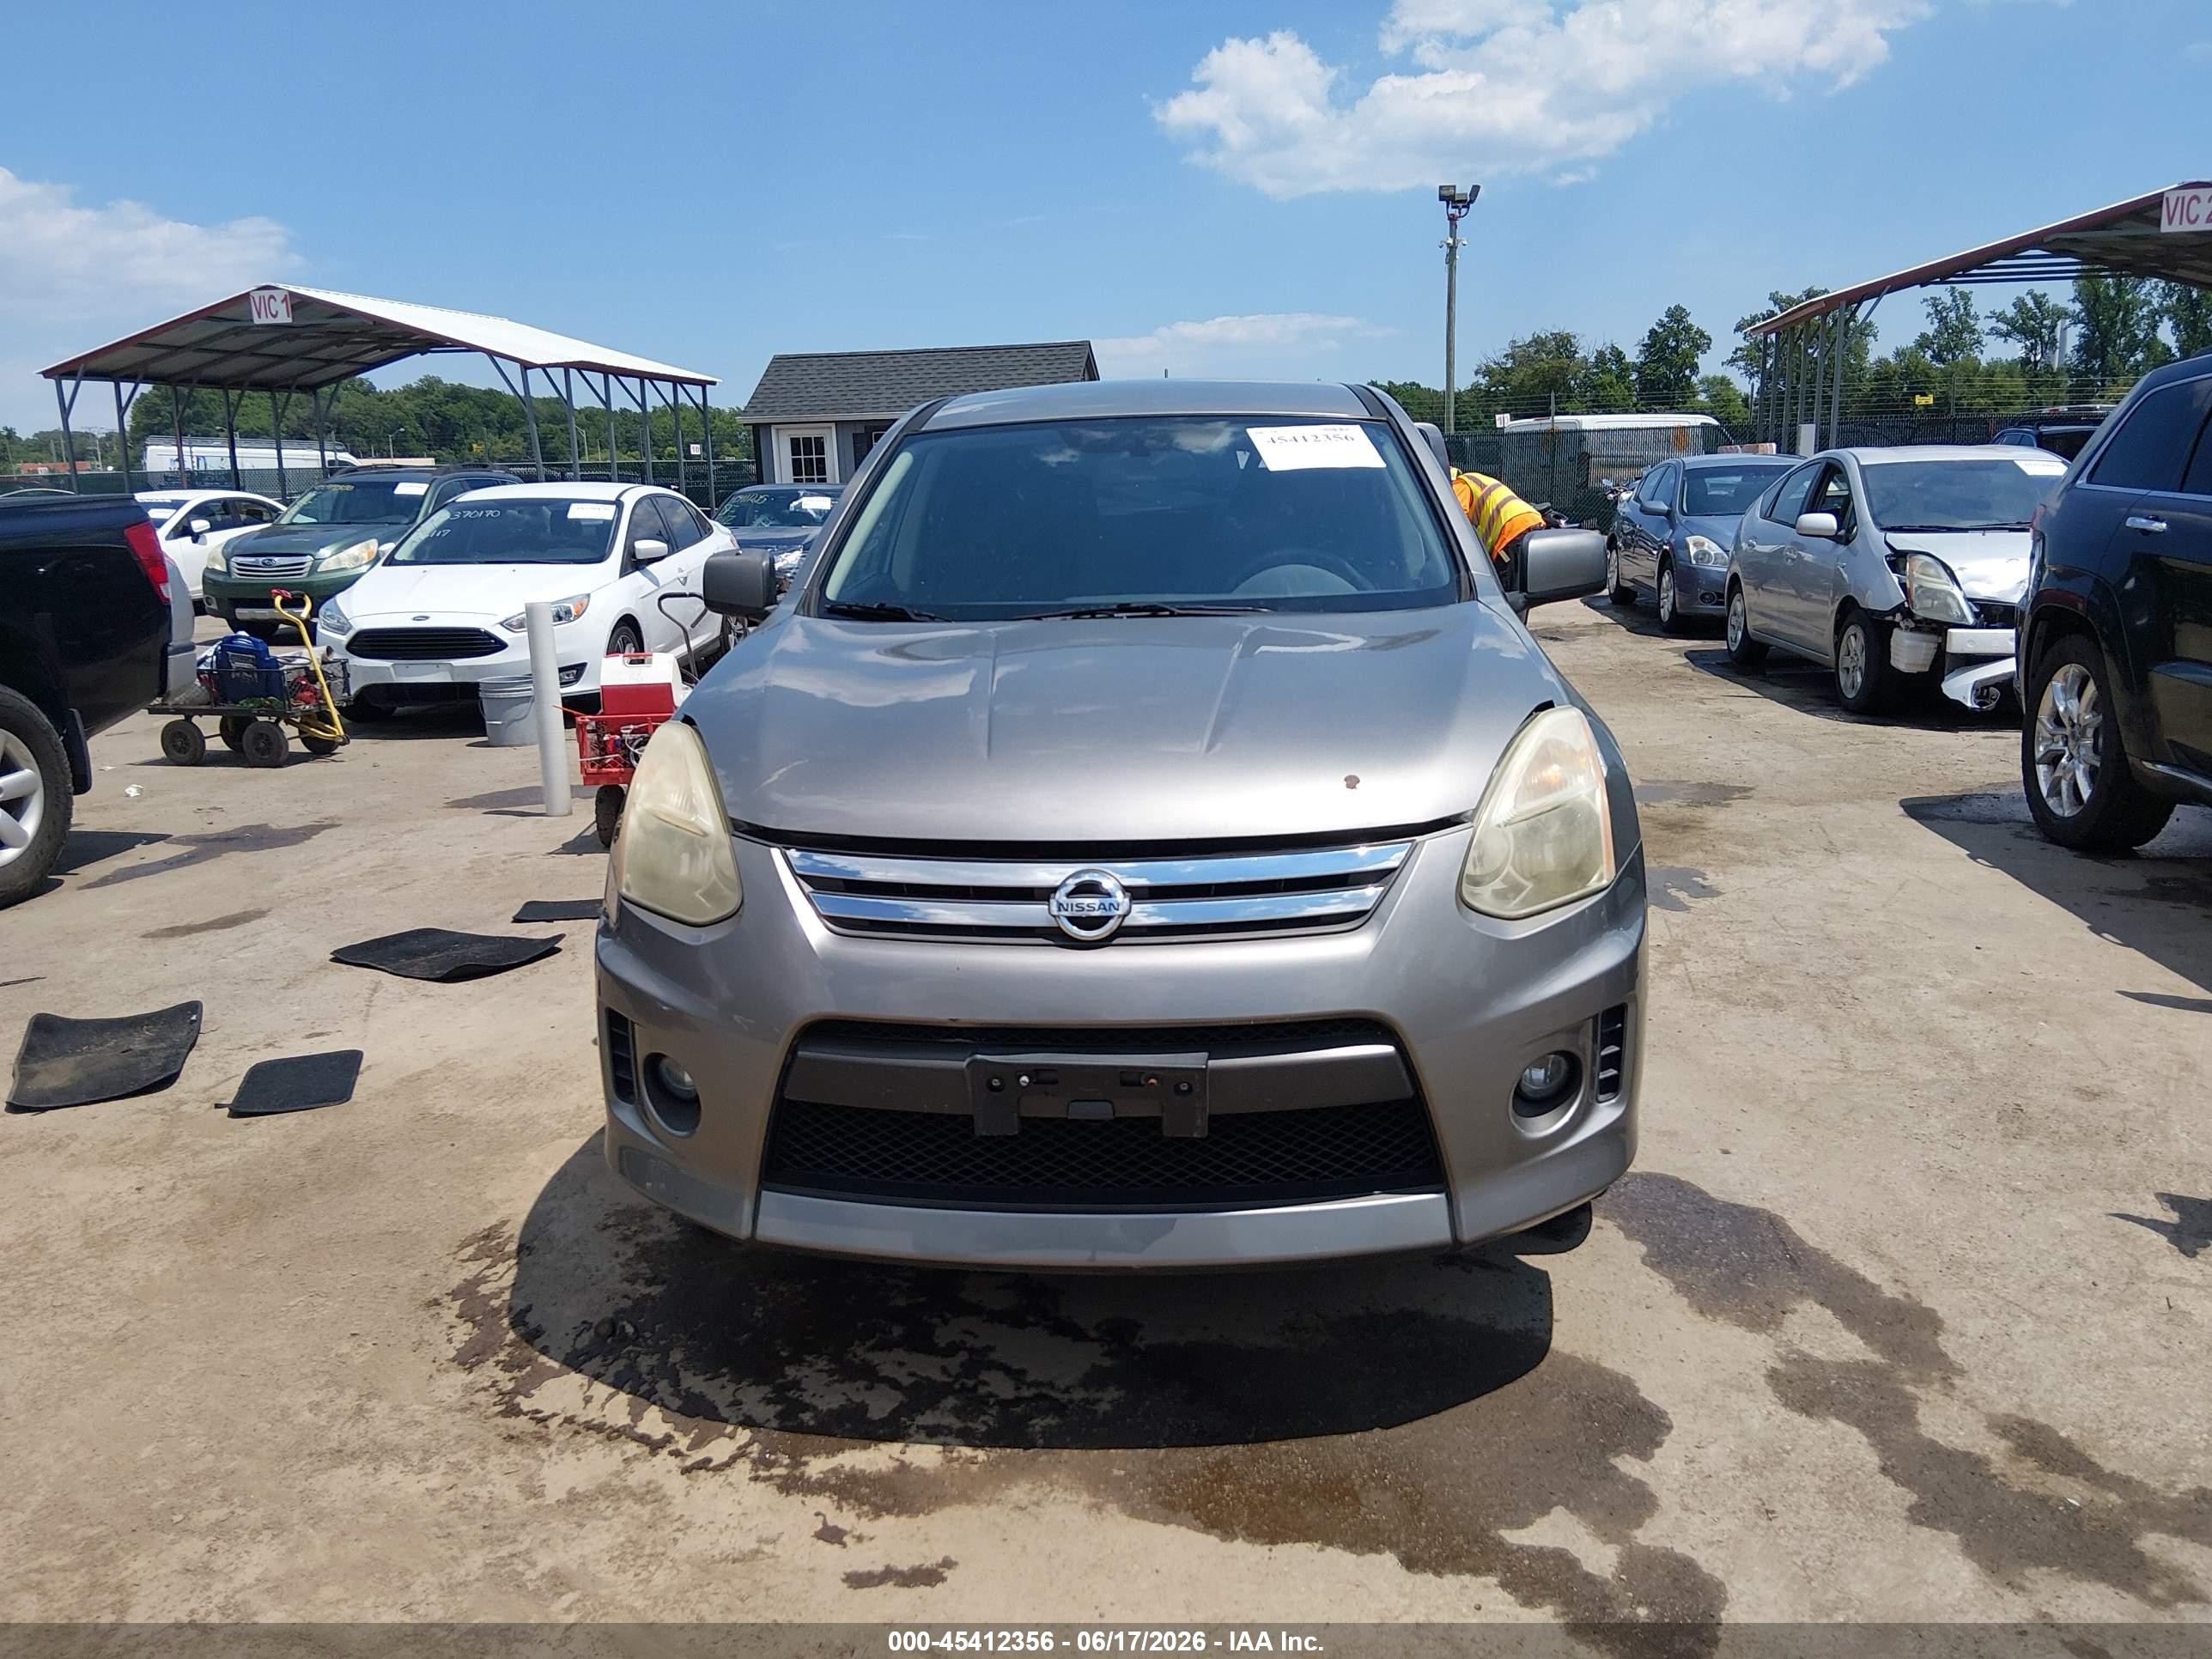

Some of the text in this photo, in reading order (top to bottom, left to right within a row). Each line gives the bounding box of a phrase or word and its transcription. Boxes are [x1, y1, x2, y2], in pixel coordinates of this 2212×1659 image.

[2166, 194, 2201, 226] VIC
[251, 294, 290, 319] VIC 1
[1056, 902, 1120, 912] NISSAN
